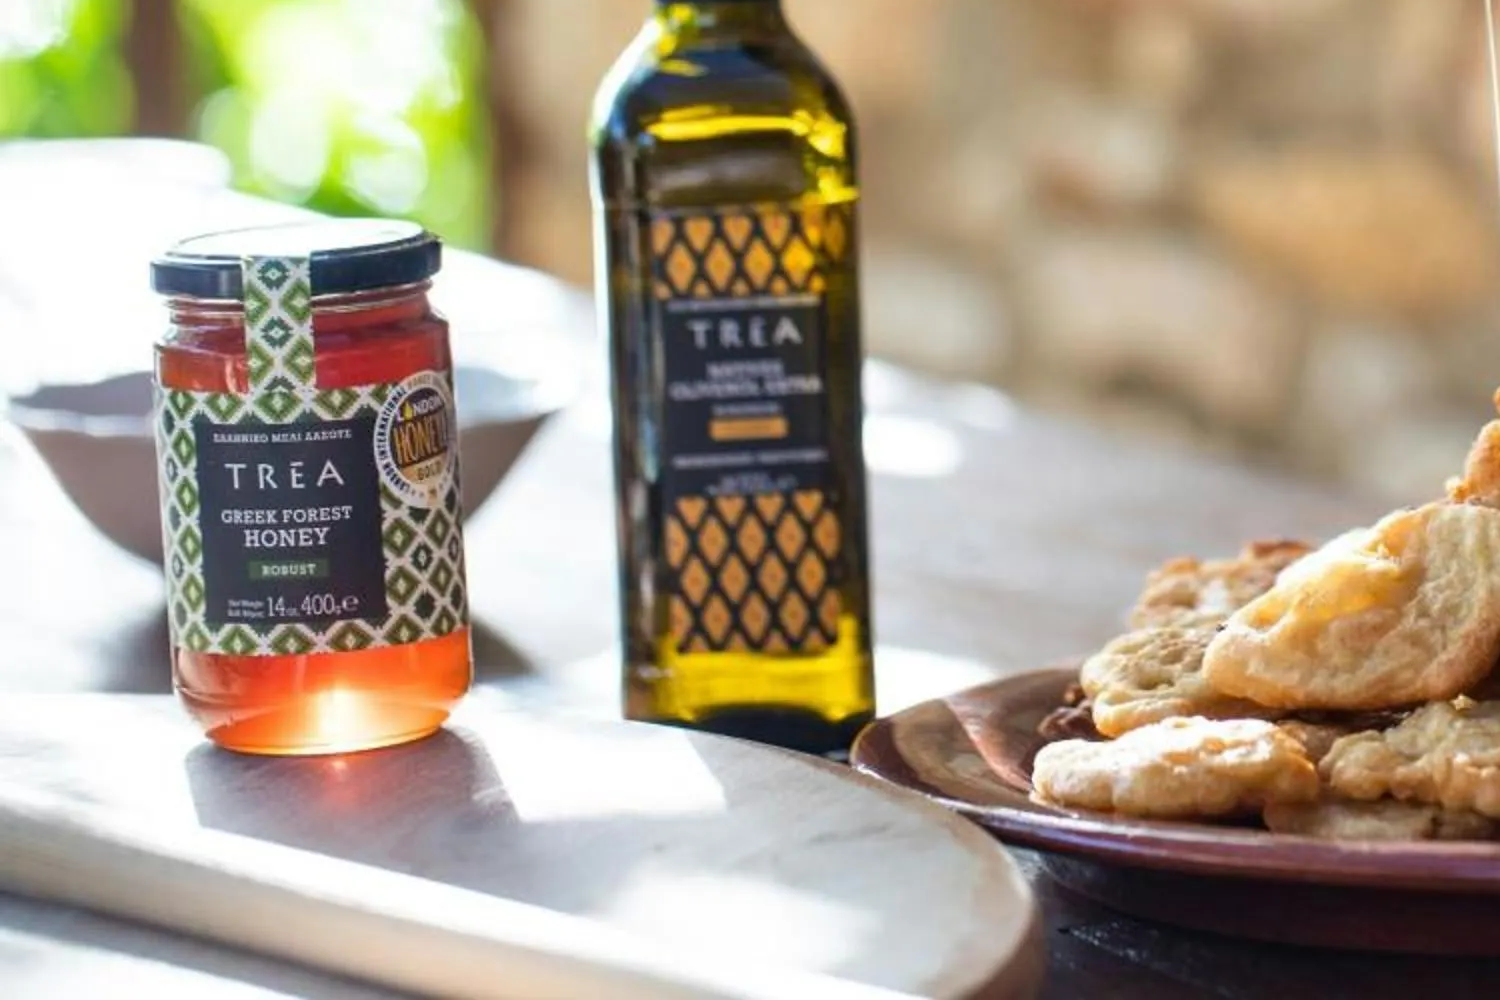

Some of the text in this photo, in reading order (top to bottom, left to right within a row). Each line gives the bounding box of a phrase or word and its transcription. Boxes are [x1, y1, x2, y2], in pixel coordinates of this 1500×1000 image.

[220, 505, 353, 525] GREEK FOREST
[243, 526, 330, 548] HONEY
[261, 563, 317, 576] ROBUST
